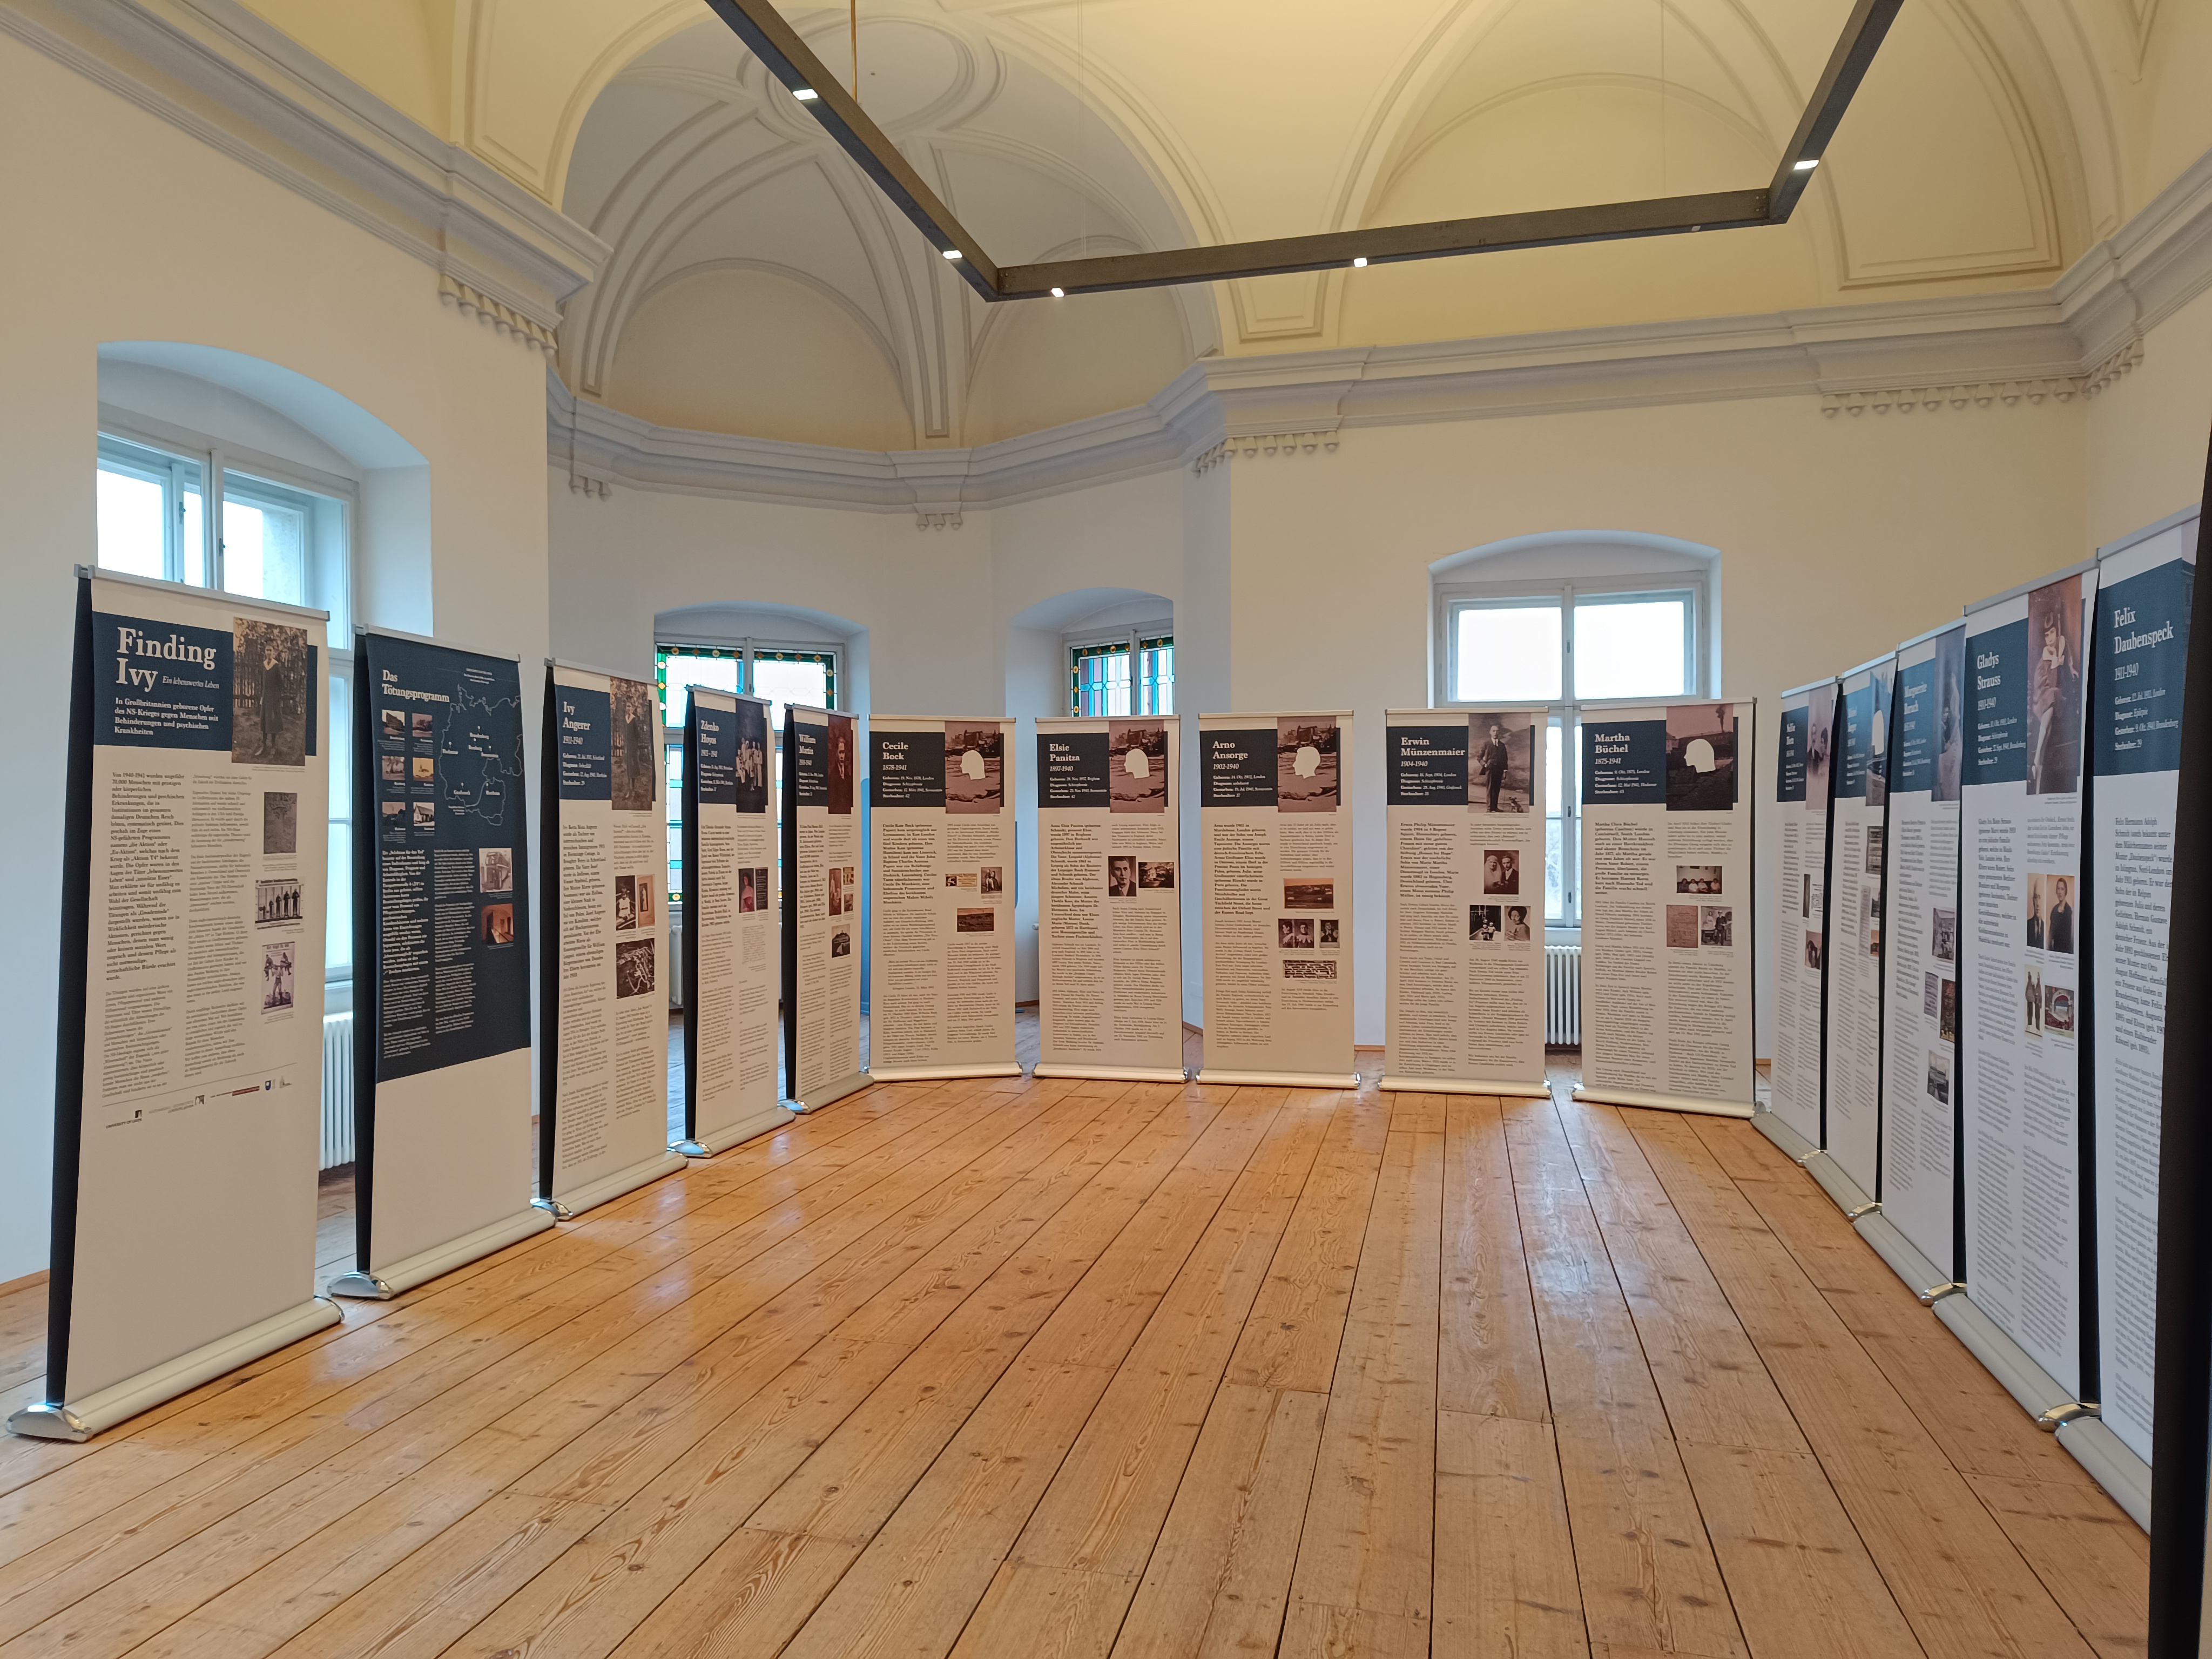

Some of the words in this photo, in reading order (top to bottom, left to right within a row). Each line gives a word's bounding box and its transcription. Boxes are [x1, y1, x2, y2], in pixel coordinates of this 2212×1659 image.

[2114, 607, 2136, 628] Felix
[2114, 620, 2174, 654] Daubenspeck
[117, 627, 217, 670] Finding
[1977, 652, 1999, 669] Gladys
[116, 657, 158, 692] Ivy
[382, 669, 398, 682] Das
[162, 675, 172, 684] Ein
[205, 680, 219, 689] Leben
[1977, 675, 2001, 690] Strauss
[381, 683, 450, 703] Tötungsprogramm
[124, 698, 172, 709] Großbritannien
[172, 702, 199, 711] geborene
[199, 704, 215, 713] Opfer
[563, 701, 575, 715] Ivy
[126, 708, 160, 718] NS-Krieges
[179, 712, 208, 720] Menschen
[115, 716, 162, 727] Behinderungen
[176, 721, 209, 730] psychischen
[562, 717, 591, 732] Angerer
[114, 726, 153, 735] Krankheiten
[1595, 733, 1630, 742] Martha
[882, 742, 909, 750] Cecile
[1401, 737, 1430, 745] Erwin
[1212, 751, 1248, 760] Ansorge
[1401, 748, 1466, 756] Münzenmaier
[1595, 744, 1628, 753] Büchel
